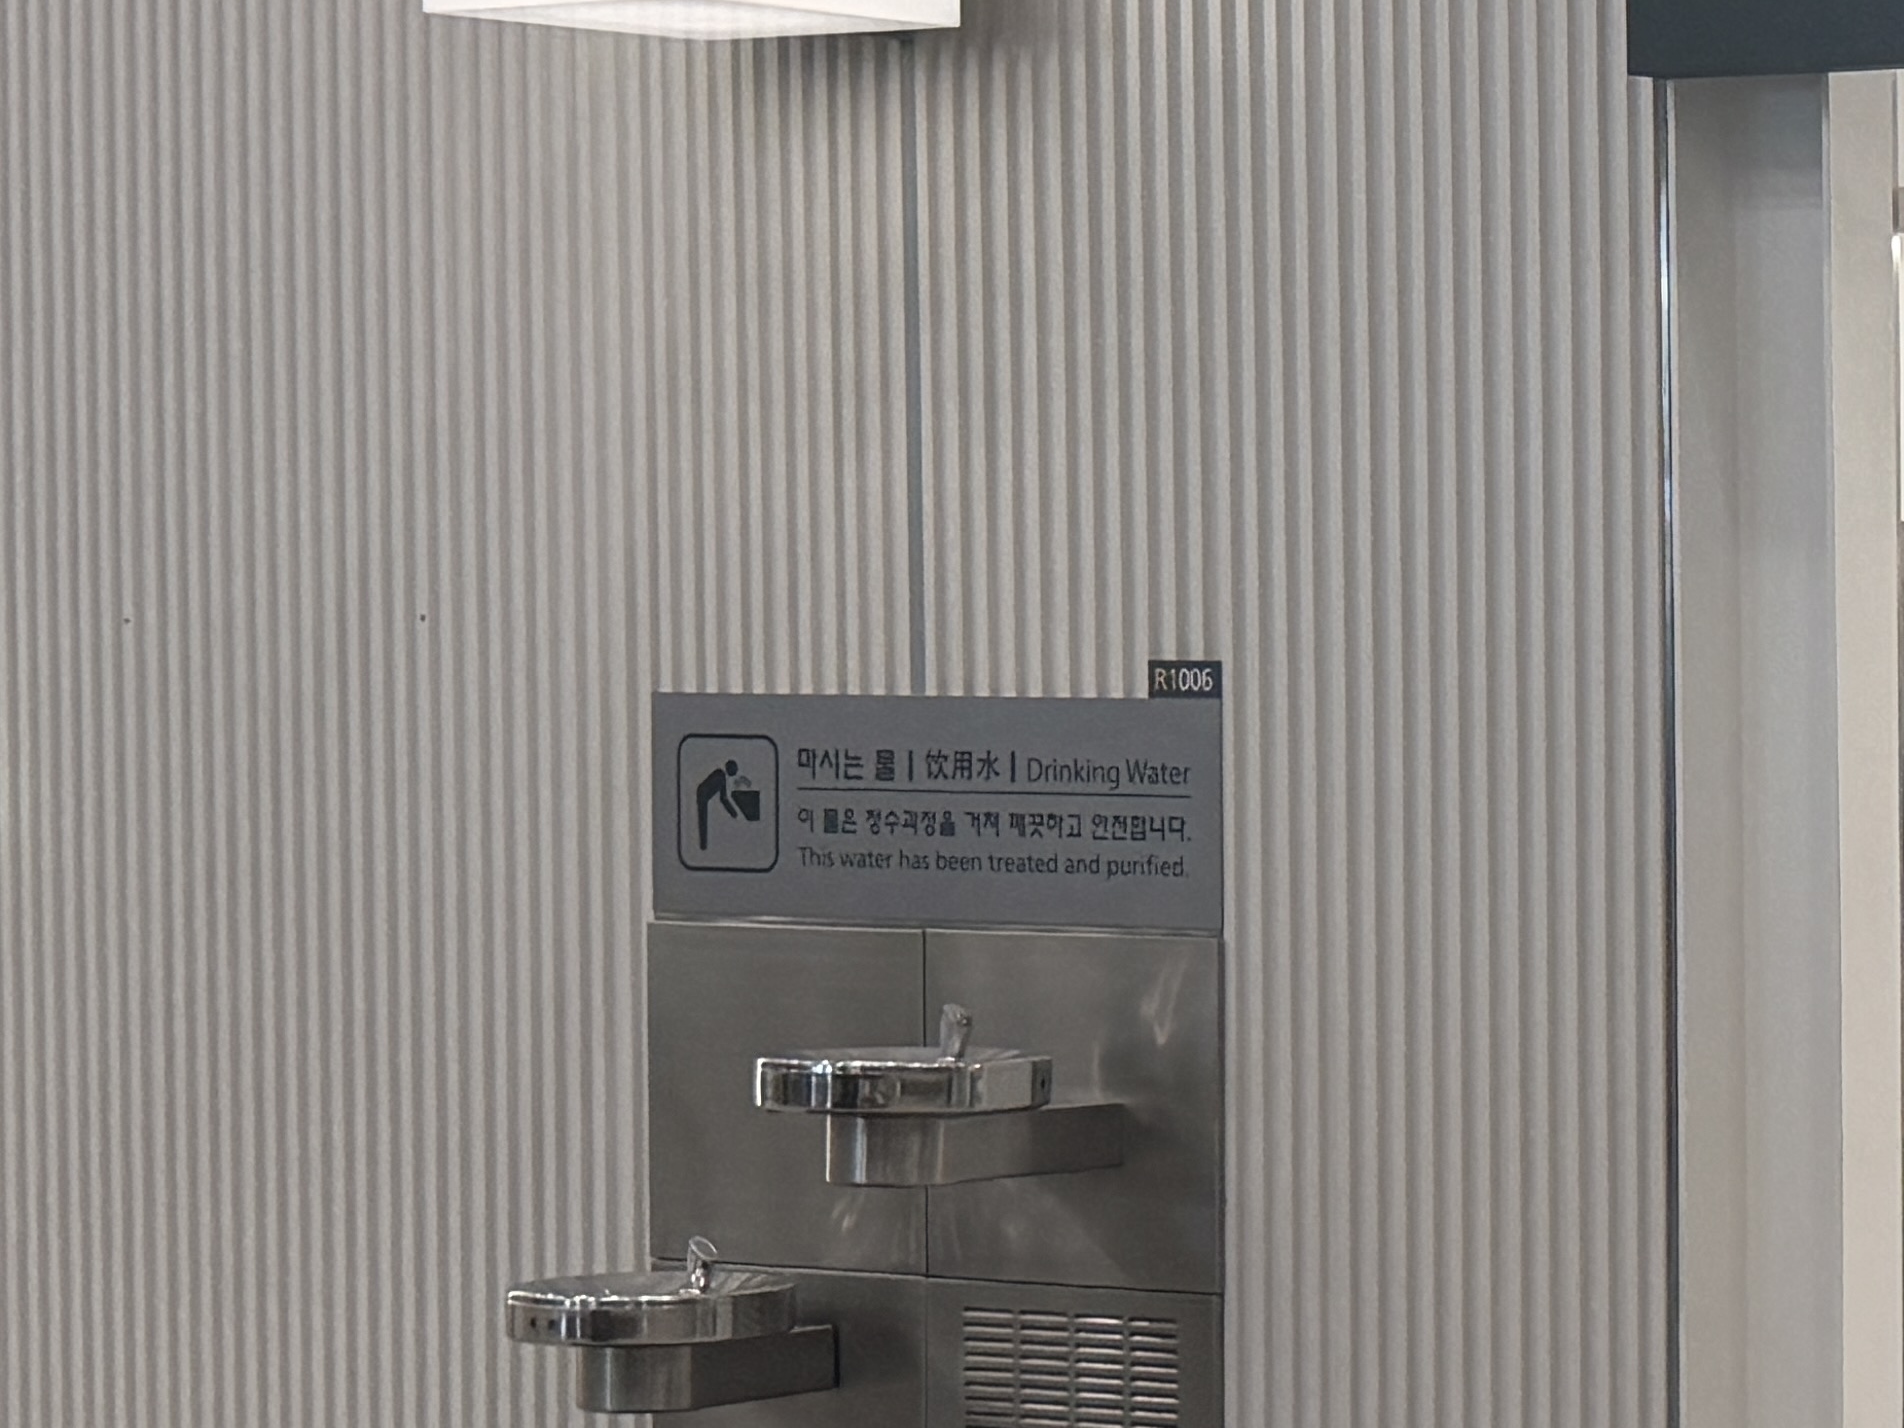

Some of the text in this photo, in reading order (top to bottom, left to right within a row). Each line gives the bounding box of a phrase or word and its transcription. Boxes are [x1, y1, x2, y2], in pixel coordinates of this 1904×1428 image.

[1154, 667, 1214, 692] R1006
[797, 747, 896, 782] 마시는 물
[925, 748, 1001, 782] 饮用水
[1026, 756, 1191, 791] Drinking Water
[797, 807, 814, 834] 이
[866, 808, 956, 838] 정수과정을
[964, 810, 1001, 838] 거쳐
[1008, 811, 1082, 839] 깨끗하고
[1091, 813, 1192, 843] 안전합니다.
[797, 846, 835, 869] This
[839, 850, 893, 870] water
[899, 848, 930, 871] has
[936, 849, 983, 873] been
[987, 852, 1059, 874] treated
[1064, 853, 1100, 874] and
